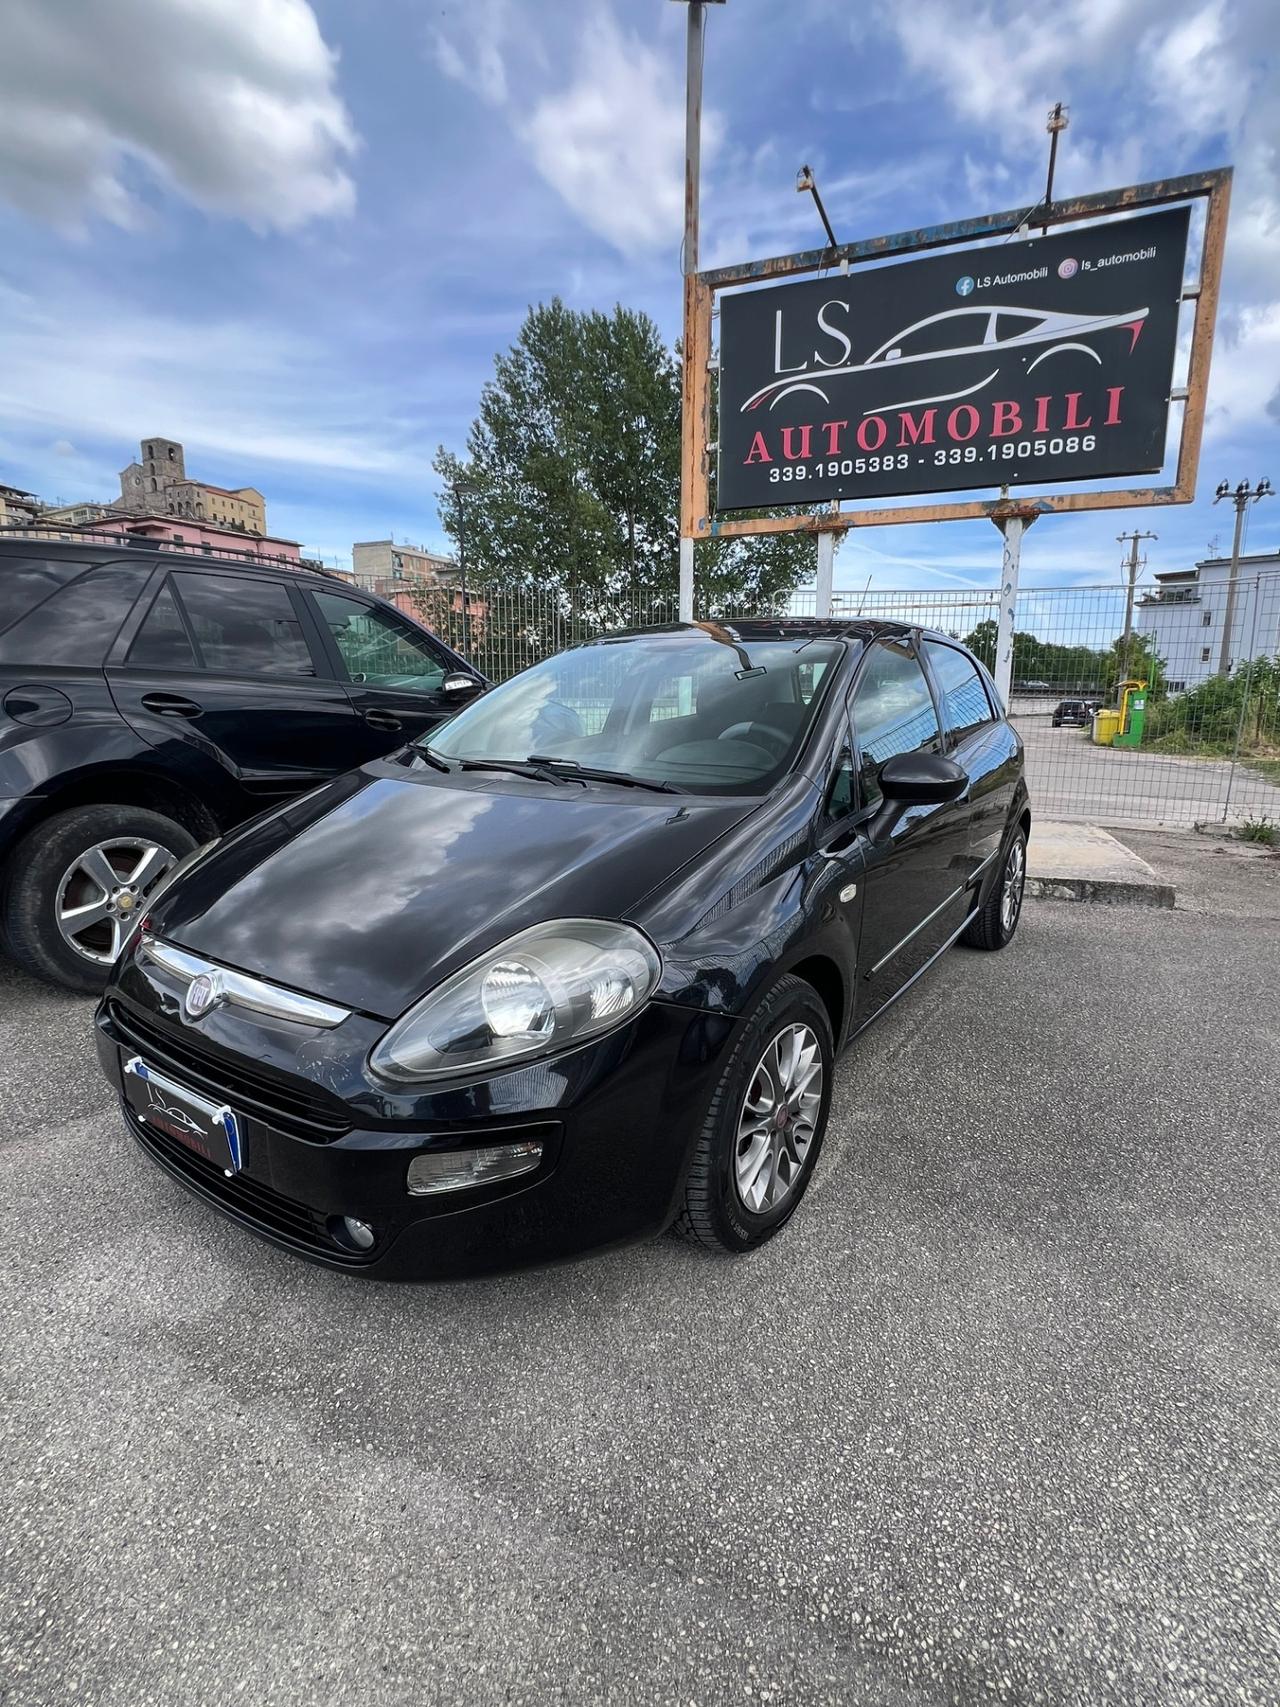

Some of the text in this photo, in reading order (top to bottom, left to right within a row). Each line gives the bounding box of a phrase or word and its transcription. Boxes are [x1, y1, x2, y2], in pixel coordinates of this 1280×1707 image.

[976, 266, 1048, 288] LS Automobili
[1081, 246, 1157, 271] ls_automobili
[743, 386, 1126, 465] AUTOMOBILI
[769, 453, 909, 483] 339.1905383
[933, 434, 1096, 466] 339.1905086
